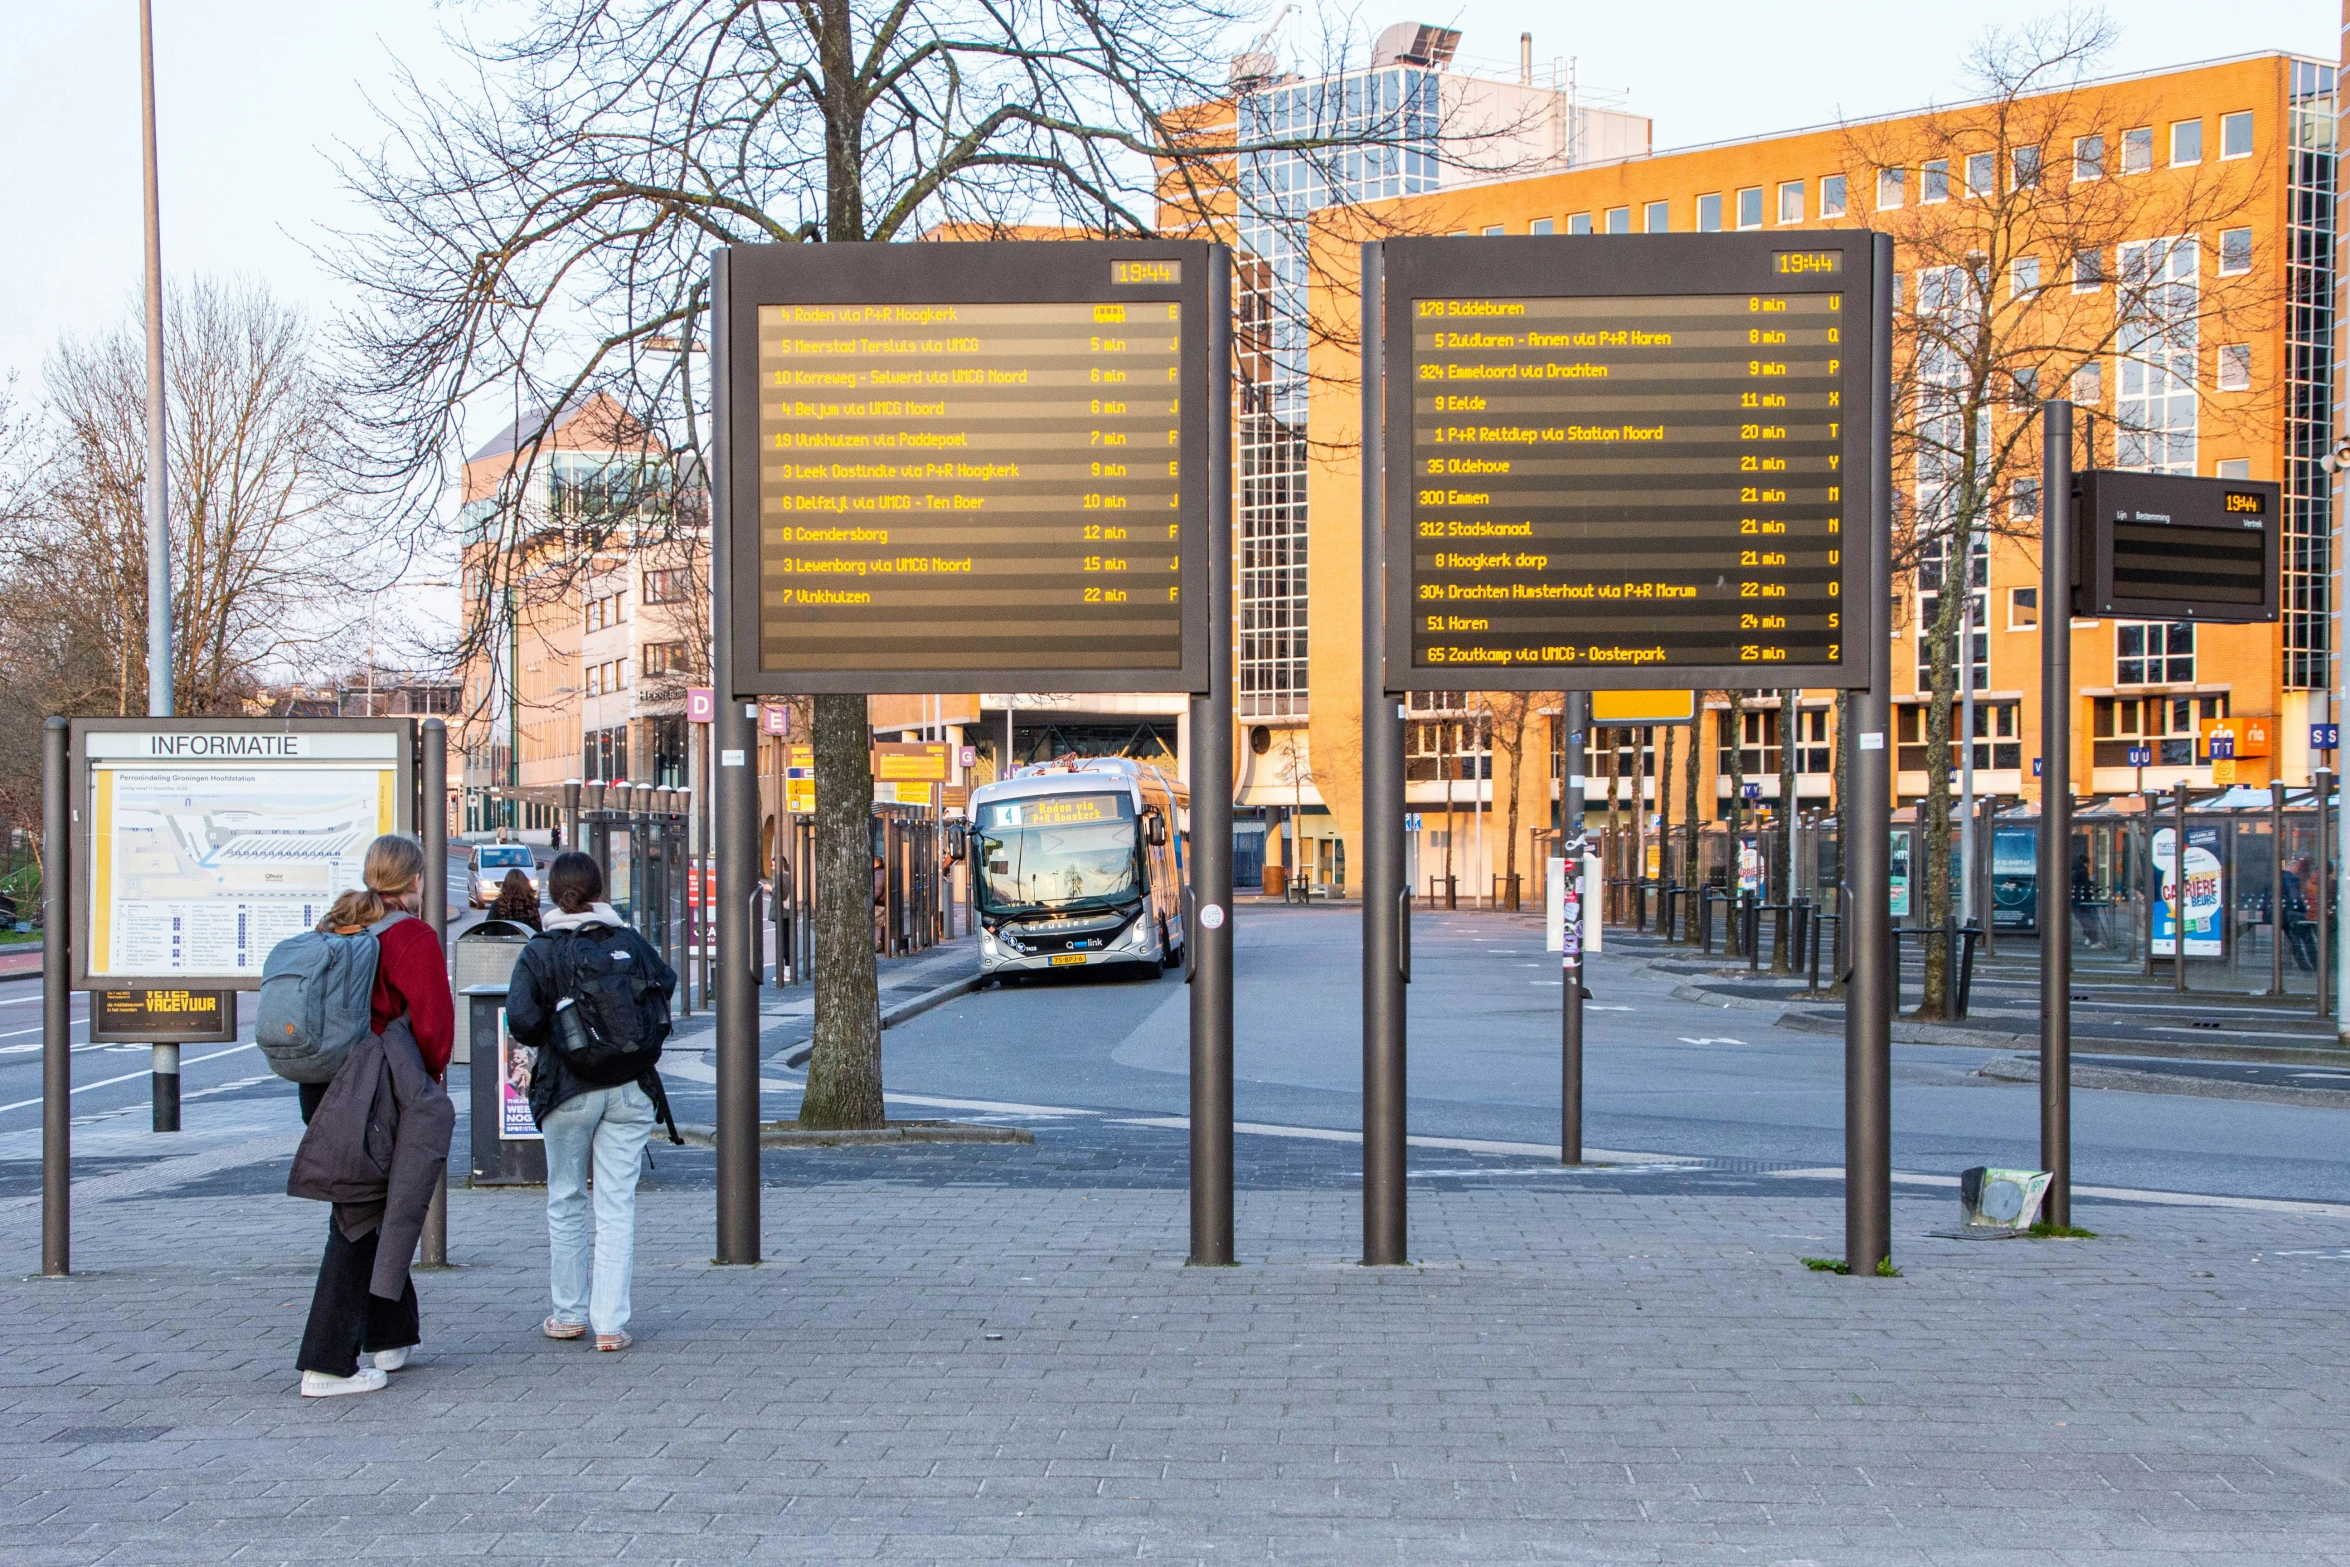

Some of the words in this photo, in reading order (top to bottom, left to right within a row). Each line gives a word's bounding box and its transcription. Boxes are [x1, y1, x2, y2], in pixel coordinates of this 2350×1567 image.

[1780, 255, 1833, 273] 19:44
[1119, 263, 1170, 282] 19:44
[781, 309, 791, 322] 4
[794, 308, 835, 323] Roden
[839, 310, 861, 323] via
[864, 307, 892, 322] P+R
[895, 308, 956, 326] Hoogkerk
[1420, 303, 1444, 317] 178
[1448, 302, 1524, 317] Siddeburen
[781, 339, 791, 355] 5
[794, 340, 857, 354] Meerstad
[860, 338, 916, 354] Tersluis
[920, 340, 943, 354] via
[946, 338, 979, 354] UMCG
[1090, 337, 1099, 352] 5
[1103, 339, 1126, 352] min
[1435, 334, 1444, 349] 5
[1448, 334, 1514, 348] Zuidlaren
[1528, 333, 1569, 347] Annen
[1573, 333, 1596, 346] via
[1600, 332, 1627, 345] P+R
[1631, 332, 1671, 346] Haren
[775, 371, 792, 386] 10
[794, 372, 857, 390] Korreweg
[870, 370, 923, 386] Selwerd
[926, 371, 948, 385] via
[951, 370, 985, 385] UMCG
[987, 370, 1027, 384] Noord
[1420, 366, 1444, 380] 324
[1448, 365, 1516, 379] Emmeloord
[1520, 365, 1543, 379] via
[1547, 364, 1608, 379] Drachten
[781, 403, 791, 416] 4
[795, 402, 840, 421] Beijum
[843, 403, 865, 417] via
[869, 402, 902, 417] UMCG
[905, 402, 945, 417] Noord
[1435, 397, 1444, 411] 9
[1448, 397, 1486, 411] Eelde
[775, 434, 792, 449] 19
[795, 434, 869, 448] Vinkhuizen
[873, 434, 896, 448] via
[898, 432, 967, 450] Paddepoel
[1436, 429, 1443, 443] 1
[1448, 428, 1476, 442] P+R
[1480, 428, 1538, 445] Reitdiep
[1542, 427, 1564, 441] via
[1568, 427, 1620, 441] Station
[1624, 427, 1663, 441] Noord
[1742, 426, 1758, 440] 20
[1763, 425, 1785, 439] min
[783, 465, 792, 480] 3
[795, 465, 827, 480] Leek
[831, 464, 897, 480] Oostindie
[900, 466, 923, 479] via
[925, 464, 954, 478] P+R
[957, 464, 1019, 482] Hoogkerk
[1428, 460, 1444, 474] 35
[1448, 460, 1510, 474] Oldehove
[782, 496, 793, 512] 6
[795, 496, 848, 515] Delfzijl
[852, 497, 875, 511] via
[878, 496, 911, 511] UMCG
[925, 495, 951, 510] Ten
[953, 495, 985, 511] Boer
[1420, 491, 1444, 506] 300
[1448, 491, 1489, 505] Emmen
[2226, 495, 2257, 512] 19:44
[2135, 511, 2171, 524] Bestemming
[2242, 519, 2263, 528] Vertrek
[783, 527, 793, 543] 8
[795, 527, 889, 546] Coendersborg
[1420, 523, 1444, 537] 312
[1448, 522, 1532, 537] Stadskanaal
[783, 558, 793, 574] 3
[795, 559, 867, 578] Lewenborg
[869, 559, 893, 574] via
[895, 558, 929, 574] UMCG
[931, 558, 972, 574] Noord
[1436, 554, 1444, 568] 8
[1448, 554, 1511, 572] Hoogkerk
[1515, 554, 1547, 571] dorp
[783, 589, 793, 604] 7
[795, 590, 871, 605] Vinkhuizen
[1084, 588, 1101, 604] 22
[1104, 588, 1127, 603] min
[1420, 586, 1444, 600] 304
[1449, 586, 1508, 599] Drachten
[1598, 585, 1620, 599] via
[1624, 585, 1652, 598] P+R
[1656, 585, 1696, 598] Marum
[1428, 617, 1444, 631] 51
[1448, 617, 1488, 631] Haren
[1428, 649, 1444, 662] 65
[1449, 649, 1512, 665] Zoutkamp
[1516, 647, 1538, 662] via
[1542, 648, 1575, 662] UMCG
[1589, 648, 1665, 665] Oosterpark
[693, 696, 709, 714] D
[770, 713, 783, 729] E
[2248, 723, 2265, 741] ria
[2312, 730, 2323, 743] S
[2328, 730, 2337, 742] S
[151, 736, 299, 756] INFORMATIE
[2212, 742, 2221, 755] T
[2223, 742, 2232, 755] T
[962, 751, 972, 762] G
[2130, 752, 2139, 763] U
[2143, 752, 2150, 763] U
[119, 774, 171, 782] Perronindeling
[172, 774, 209, 782] Groningen
[210, 774, 256, 782] Hoofdstation
[1745, 785, 1751, 794] Y
[1753, 785, 1759, 794] Y
[1005, 807, 1013, 824] 4
[2191, 894, 2217, 908] BEURS
[1087, 937, 1103, 947] link
[146, 997, 216, 1012] VAGEVUUR
